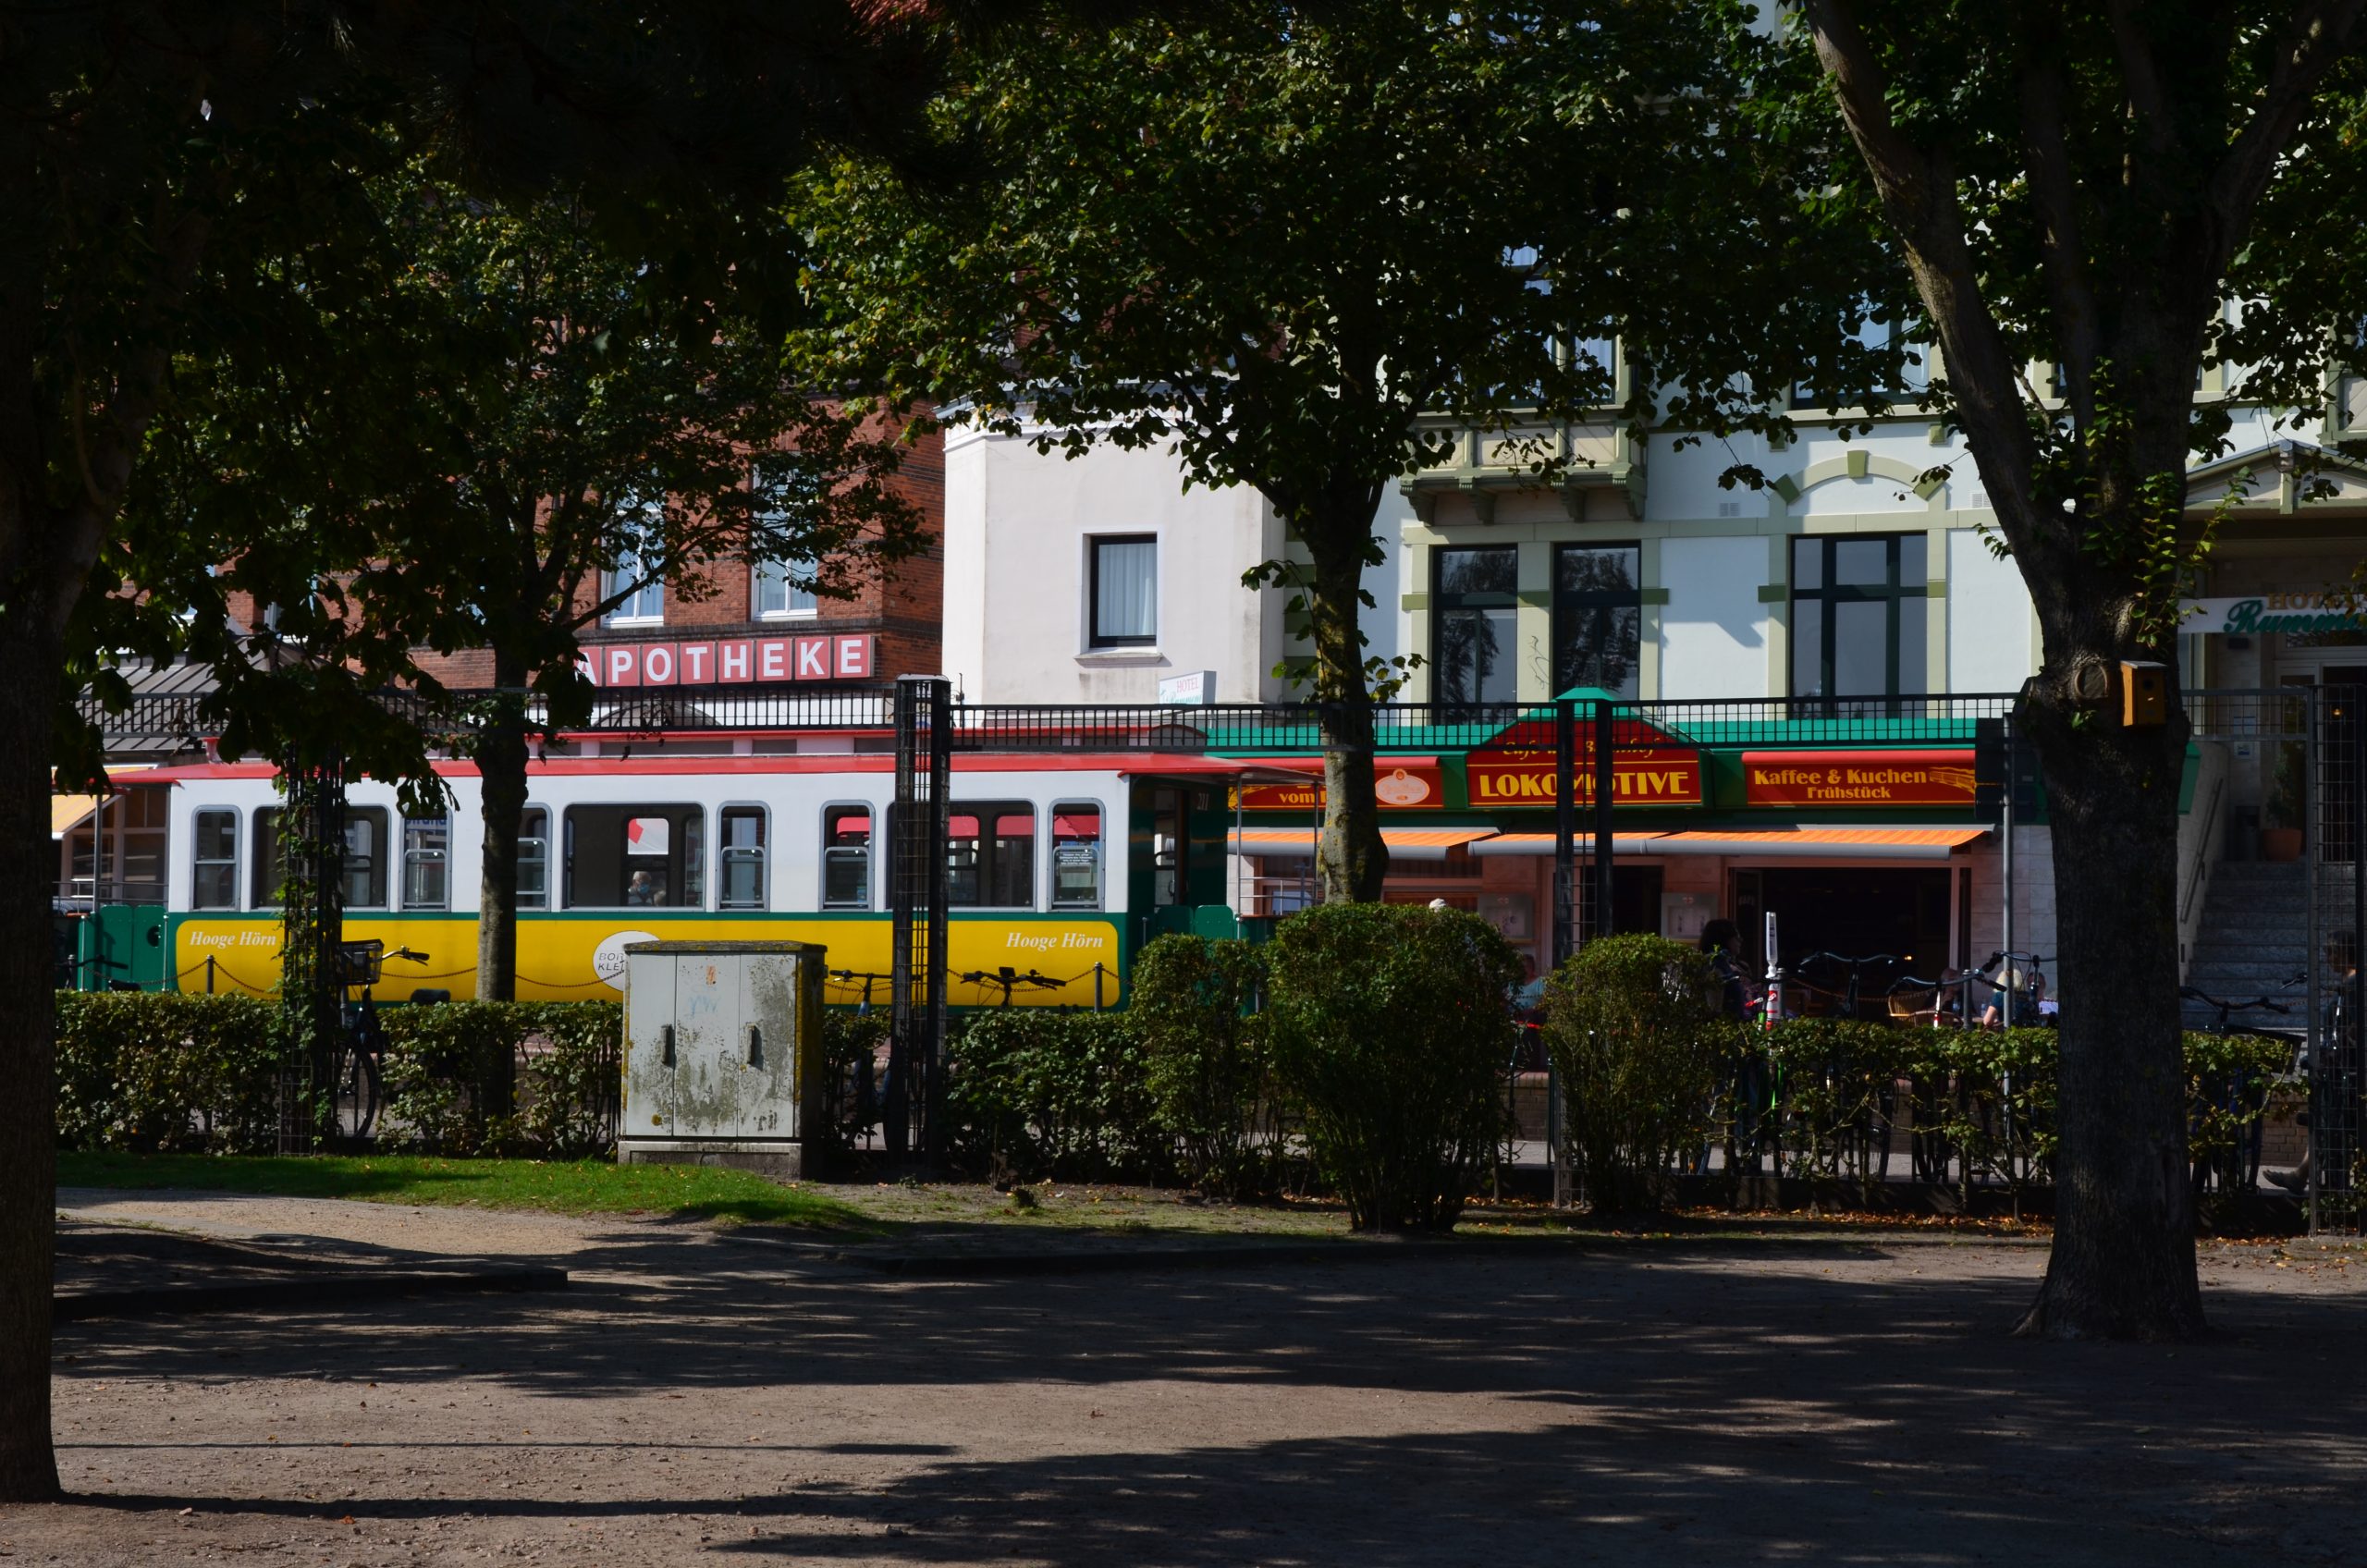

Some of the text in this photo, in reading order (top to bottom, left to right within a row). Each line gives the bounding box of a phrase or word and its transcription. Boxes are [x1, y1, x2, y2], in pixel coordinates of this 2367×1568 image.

[1176, 678, 1199, 693] HOTEL
[1754, 768, 1927, 785] Kaffee & Kuchen
[1279, 792, 1316, 804] vom
[1807, 786, 1892, 800] Frühstück
[190, 931, 276, 949] Hooge Hörn
[1006, 932, 1103, 952] Hooge Hörn
